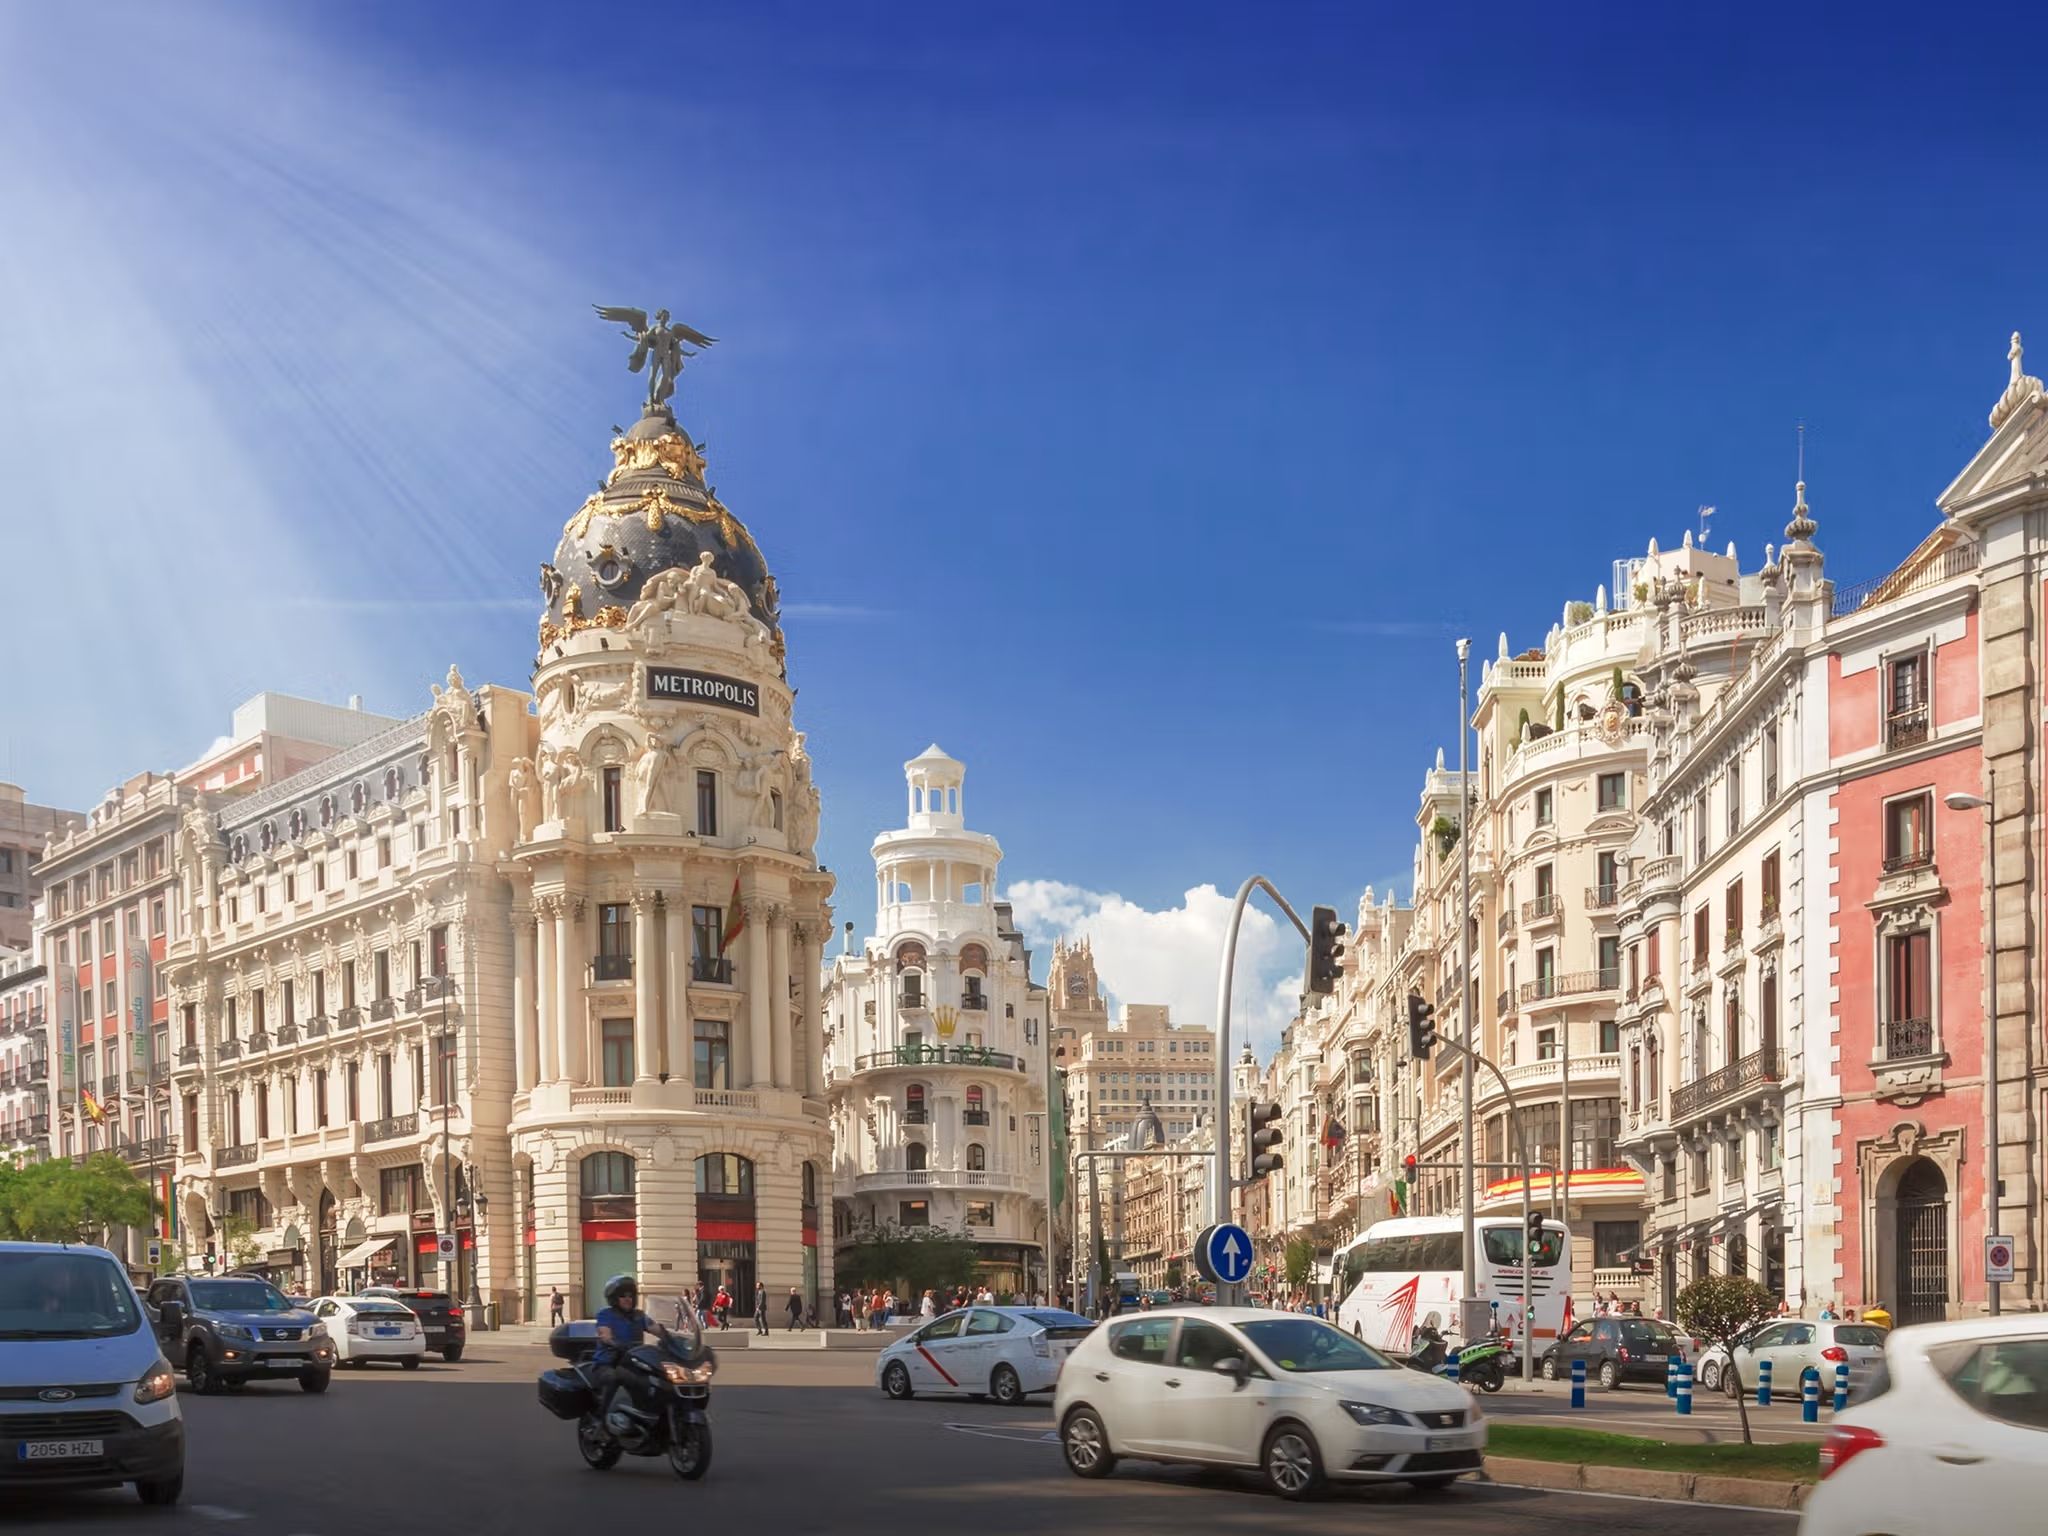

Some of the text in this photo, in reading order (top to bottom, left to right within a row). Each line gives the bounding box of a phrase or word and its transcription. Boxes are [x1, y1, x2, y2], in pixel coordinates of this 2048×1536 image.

[654, 674, 756, 707] METROPOLIS
[893, 1043, 997, 1066] ROLEX
[30, 1442, 98, 1457] 2056 HZL
